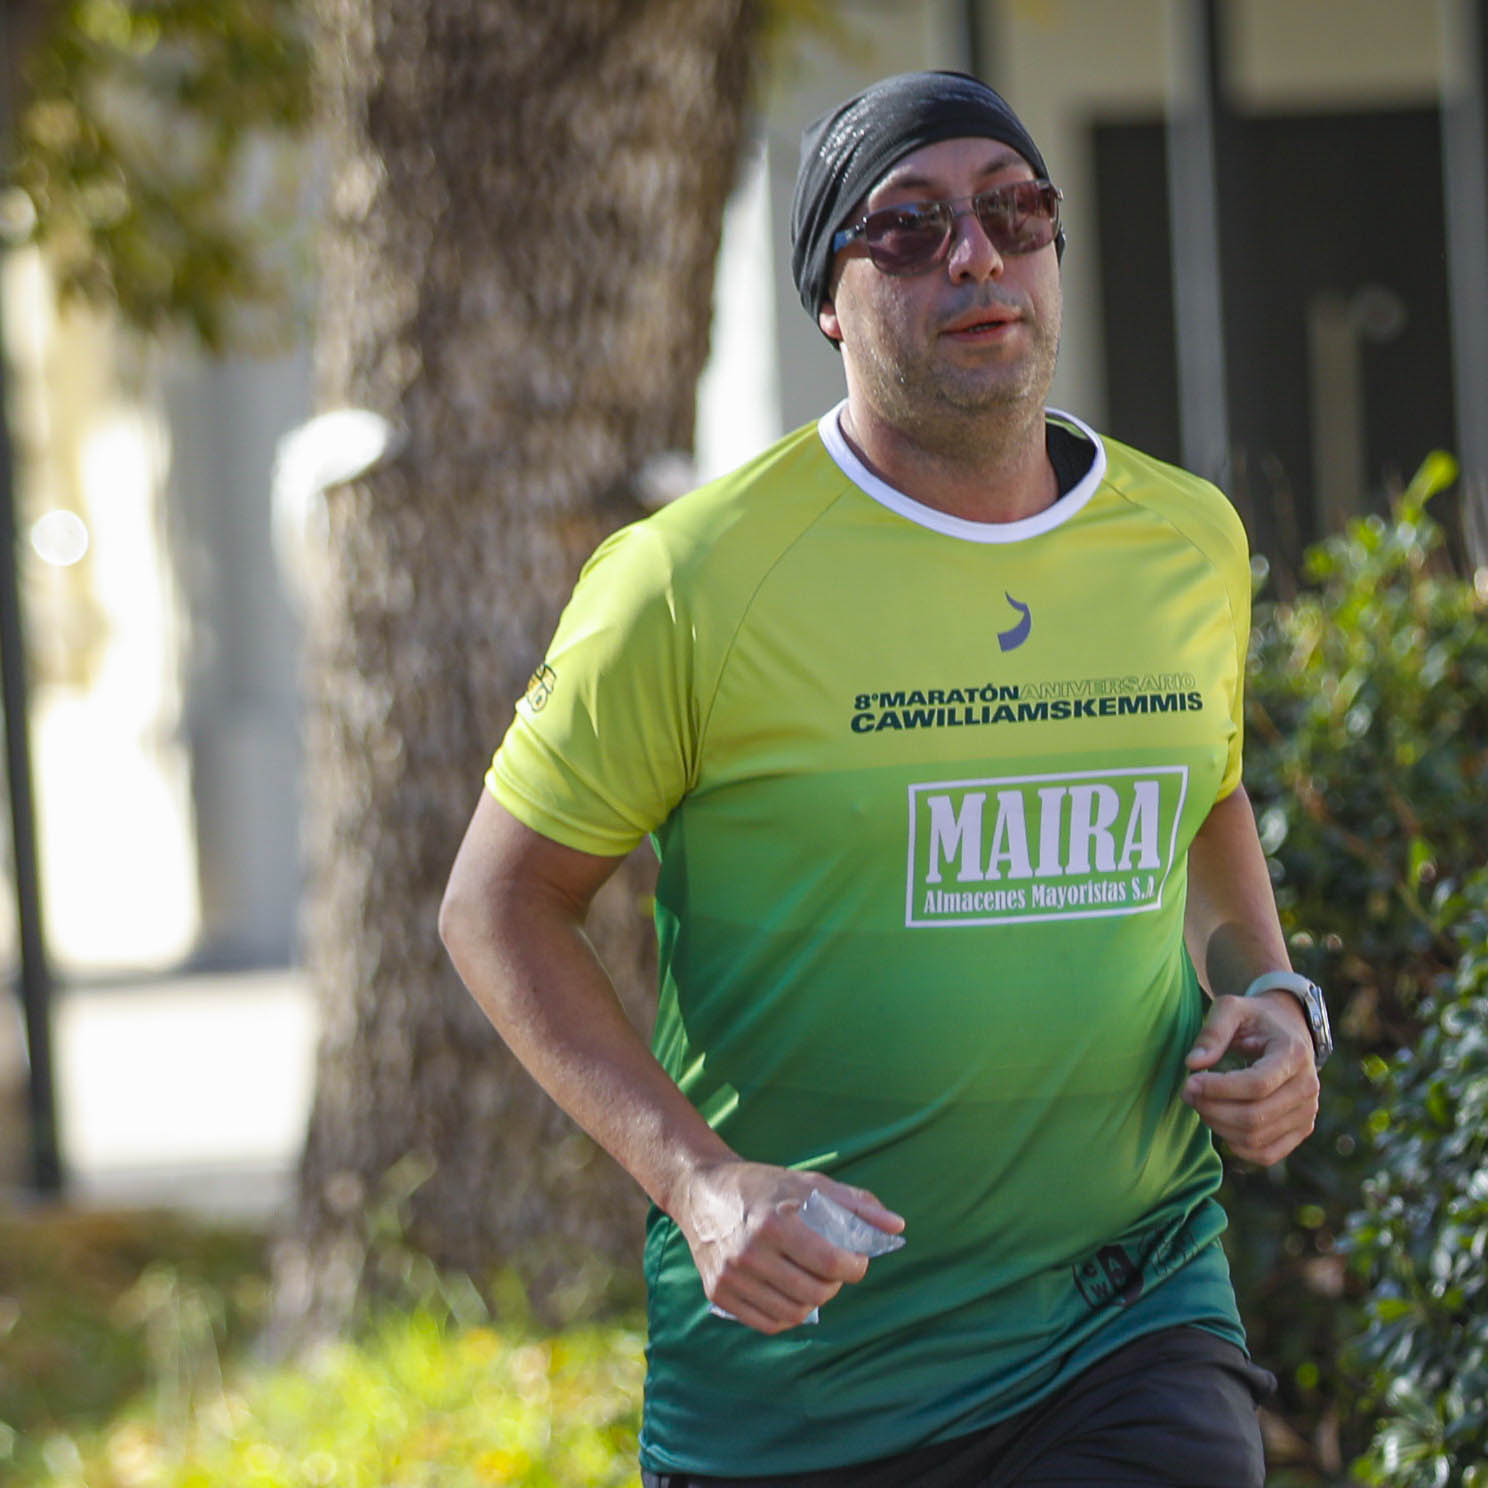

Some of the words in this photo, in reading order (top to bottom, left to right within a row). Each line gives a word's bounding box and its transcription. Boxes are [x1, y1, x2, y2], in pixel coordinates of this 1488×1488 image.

[925, 781, 1161, 884] MAIRA
[923, 889, 1026, 914] Almacenes
[1031, 879, 1126, 909] Mayoristas
